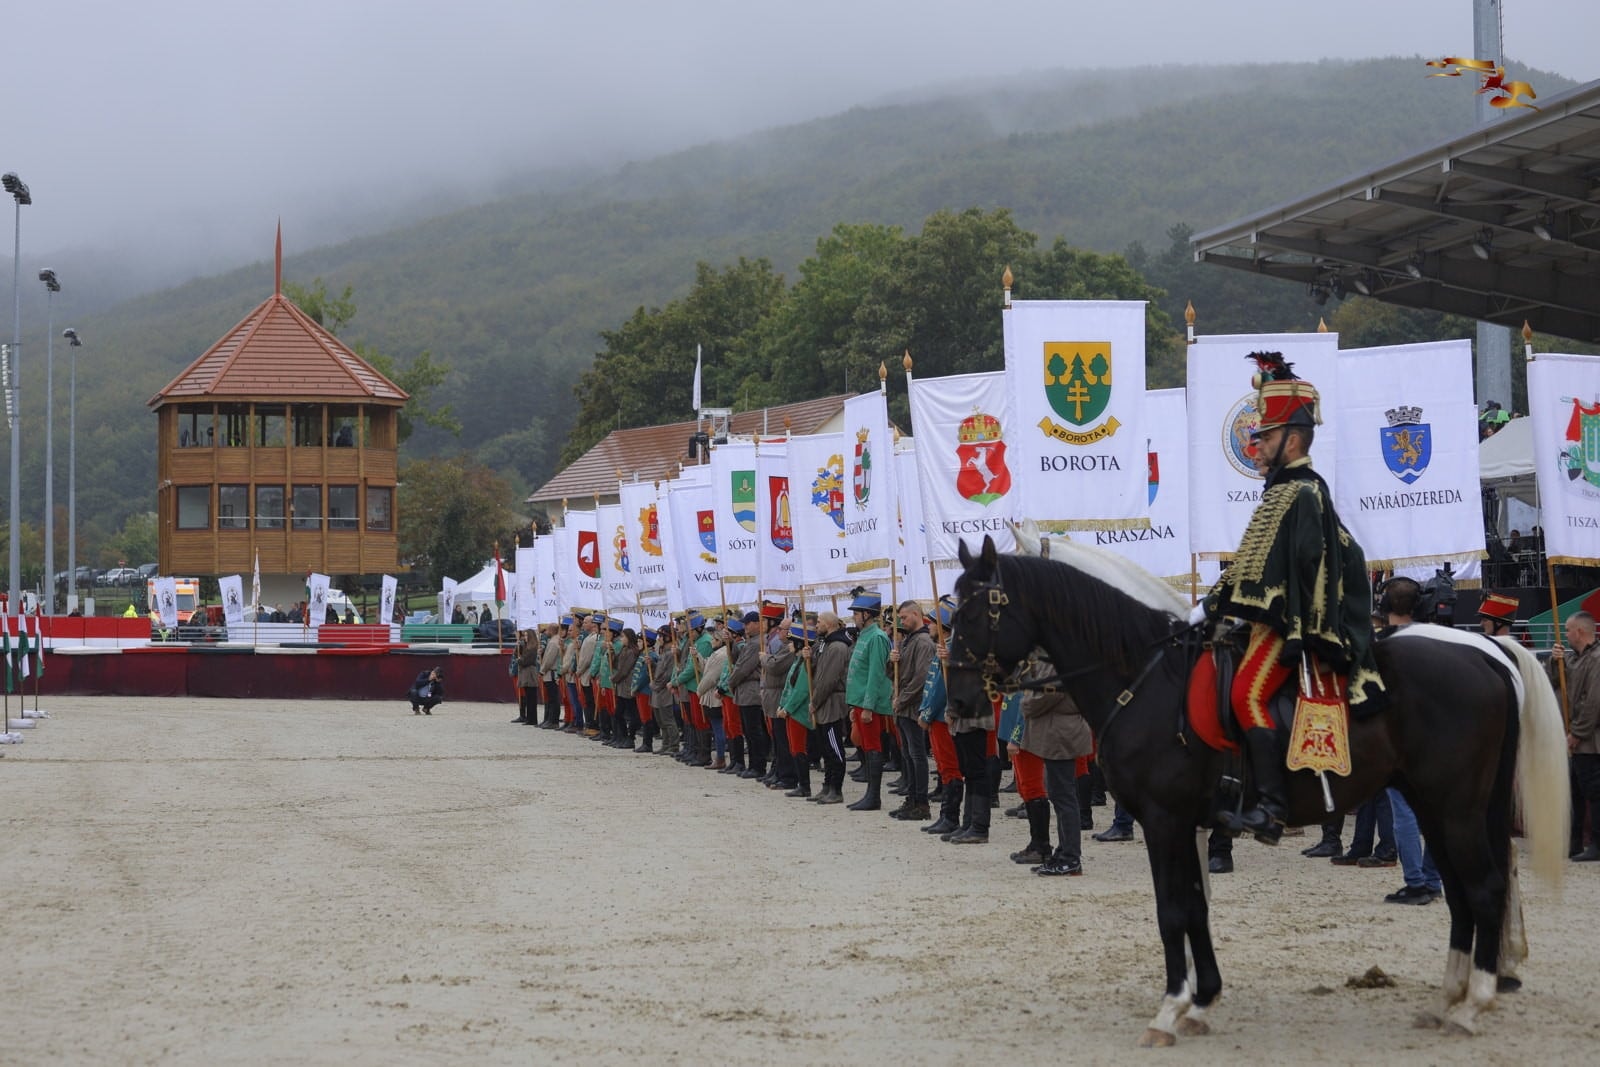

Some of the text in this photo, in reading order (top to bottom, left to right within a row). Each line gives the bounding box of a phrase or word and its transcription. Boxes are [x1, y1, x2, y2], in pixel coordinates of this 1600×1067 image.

[1058, 430, 1102, 443] BOROTA
[1040, 455, 1121, 472] BOROTA
[1359, 488, 1463, 511] NYÁRÁDSZEREDA
[1095, 525, 1175, 545] KRASZNA
[579, 581, 602, 590] VISZ
